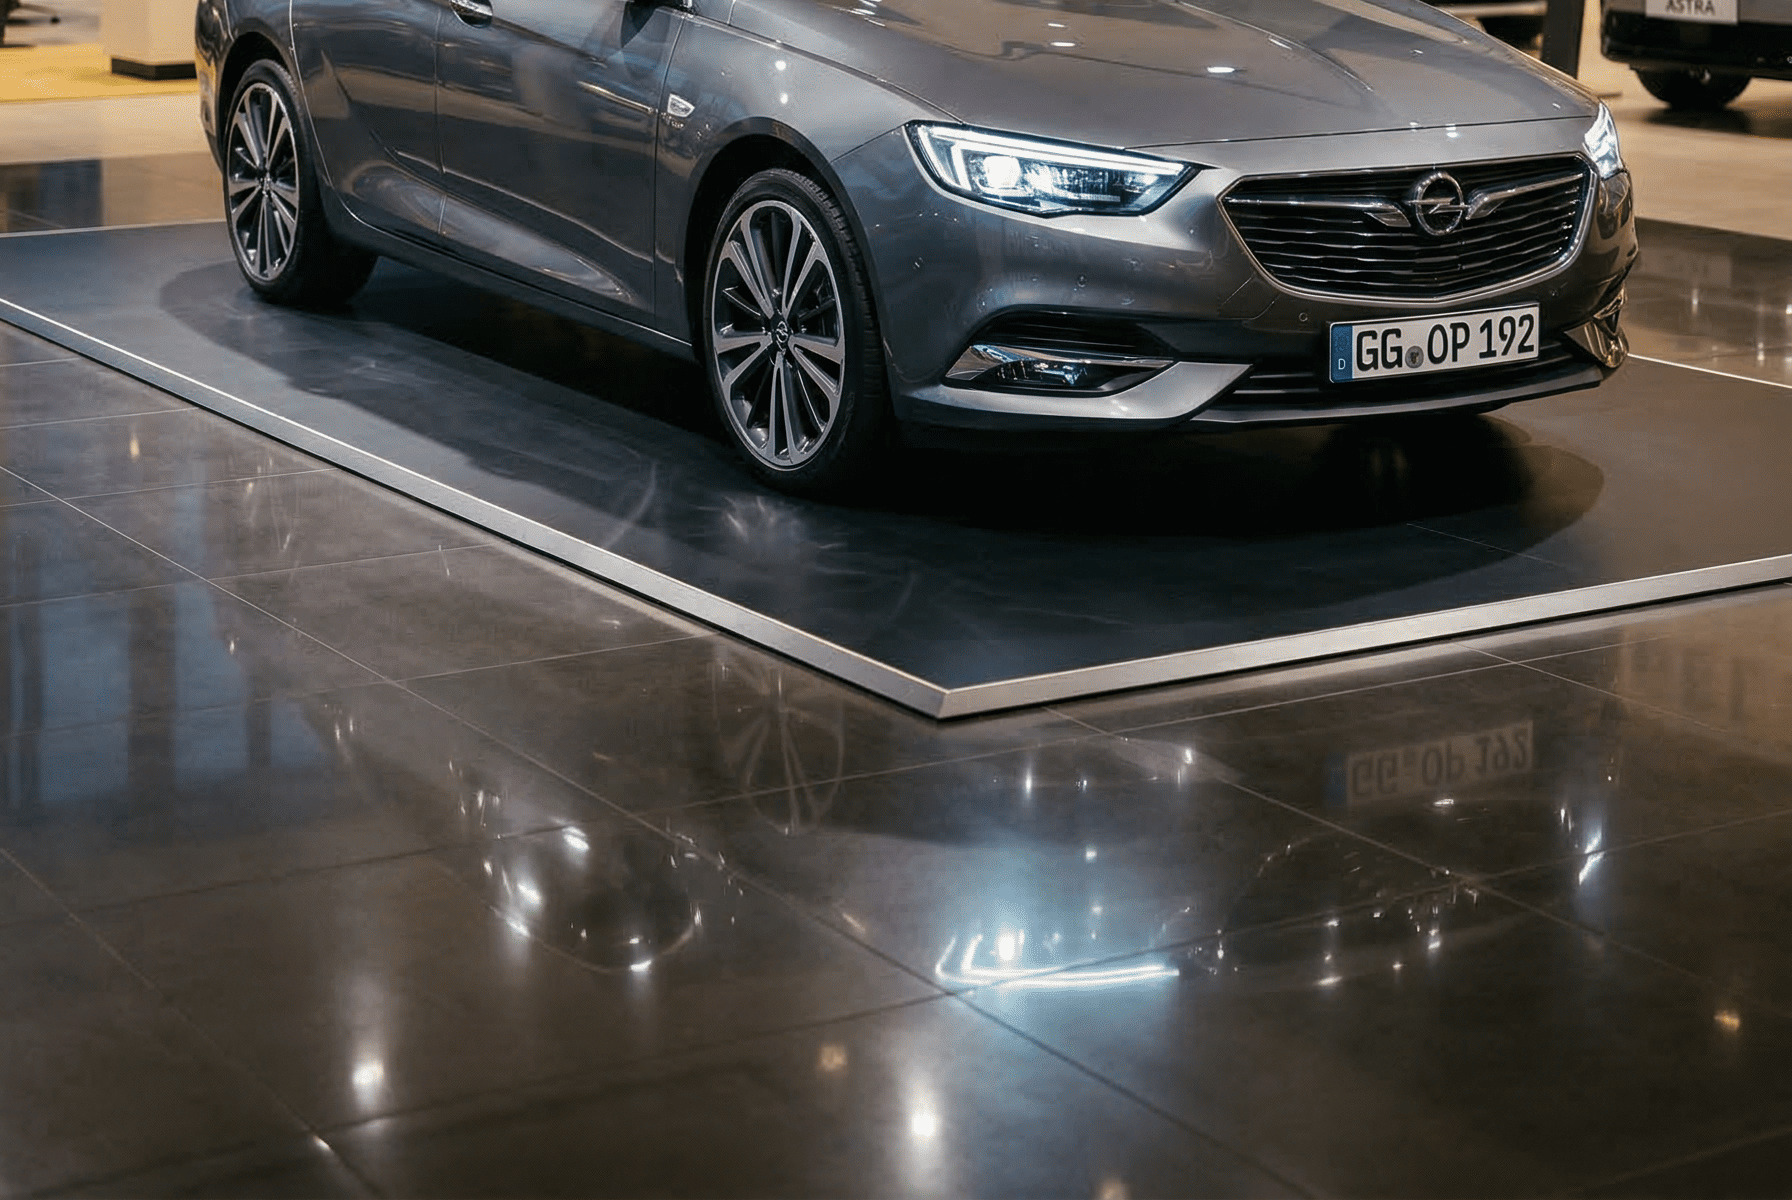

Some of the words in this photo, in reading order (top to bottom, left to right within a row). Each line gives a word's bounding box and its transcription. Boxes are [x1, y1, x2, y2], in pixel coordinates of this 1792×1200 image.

[1356, 328, 1403, 372] GG
[1427, 323, 1471, 365] OP
[1478, 313, 1535, 359] 192
[1338, 358, 1346, 370] D
